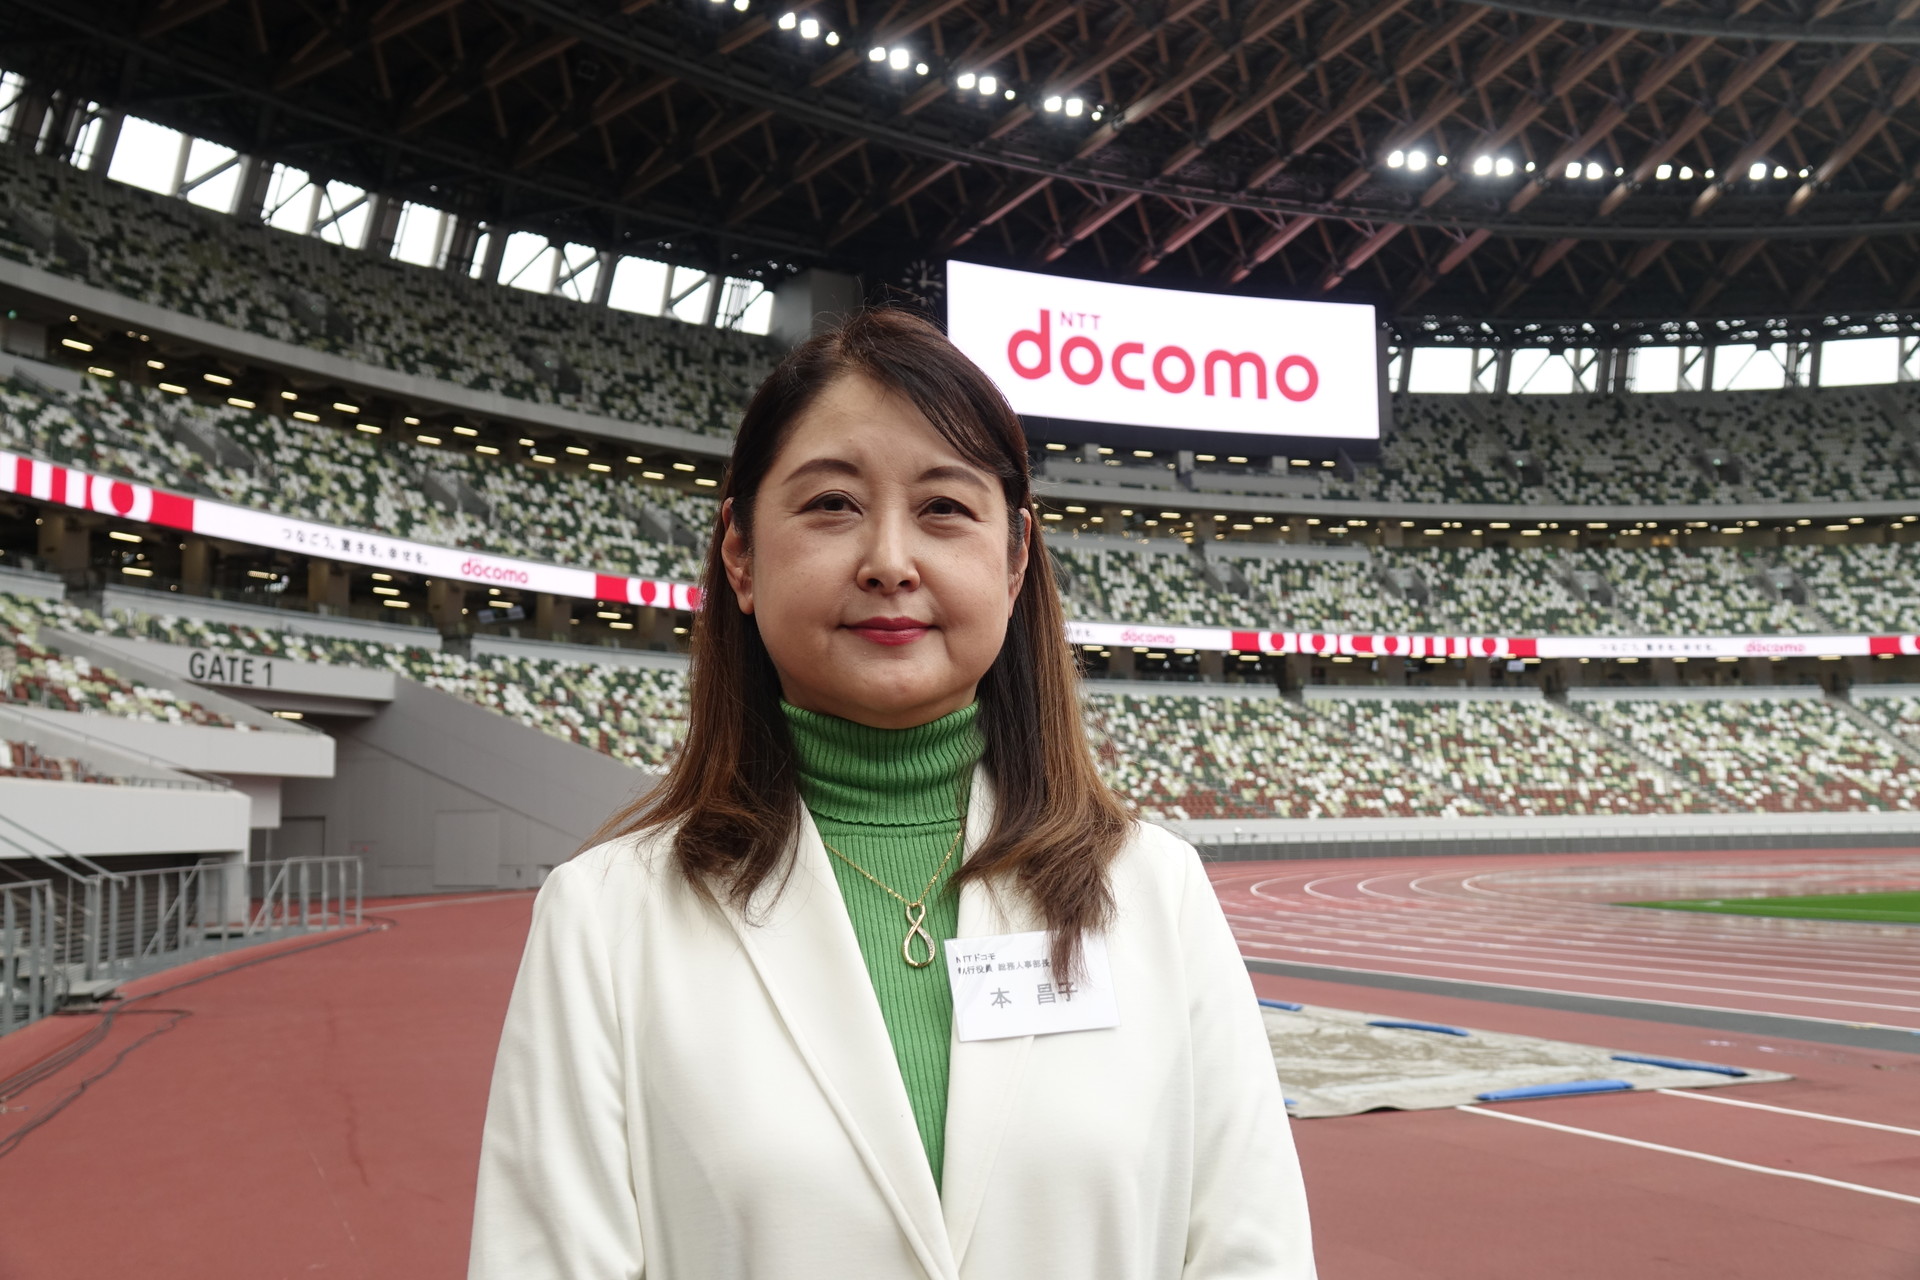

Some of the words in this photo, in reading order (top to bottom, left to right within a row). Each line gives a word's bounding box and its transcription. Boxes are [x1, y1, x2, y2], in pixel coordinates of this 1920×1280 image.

[1060, 311, 1101, 330] NTT
[1007, 308, 1320, 402] docomo
[461, 558, 529, 584] docomo
[189, 651, 253, 685] GATE
[262, 661, 272, 687] 1
[990, 987, 1012, 1008] 本
